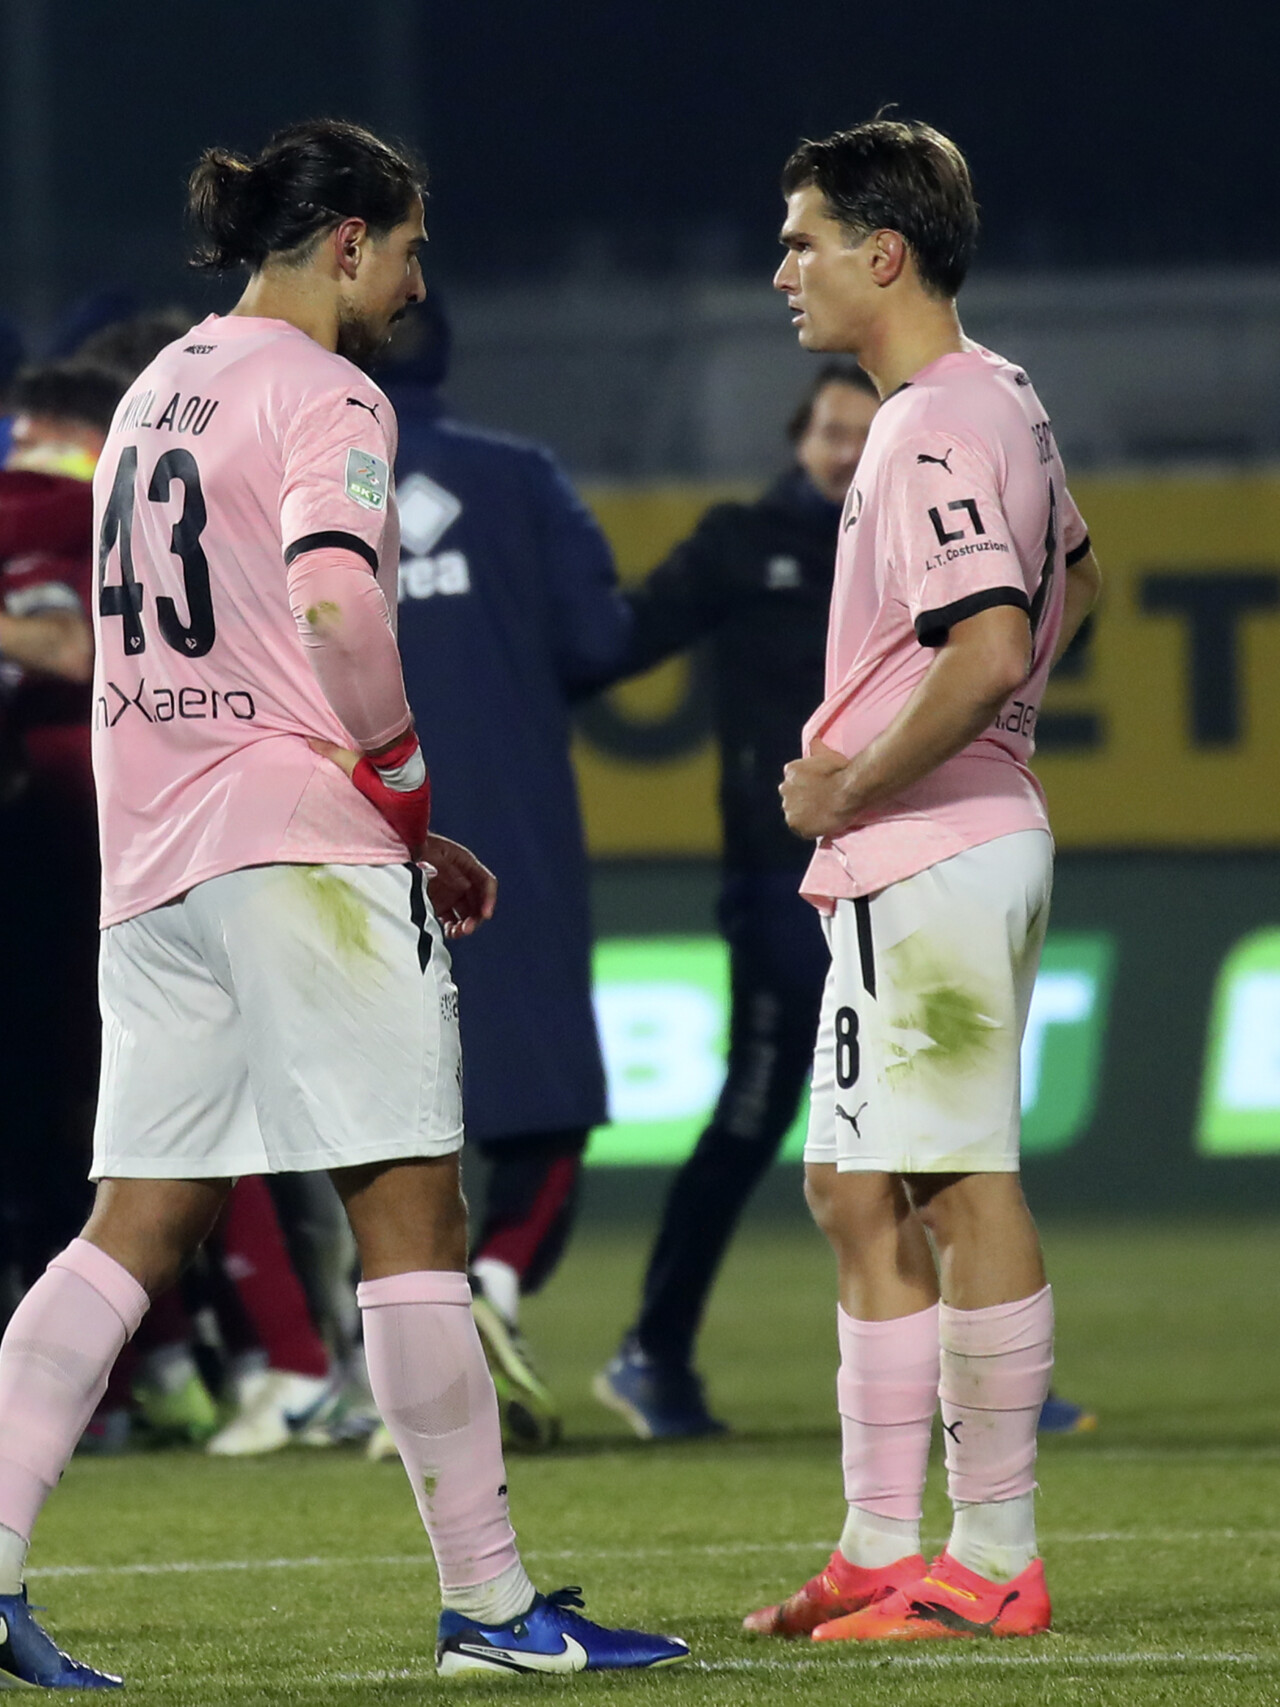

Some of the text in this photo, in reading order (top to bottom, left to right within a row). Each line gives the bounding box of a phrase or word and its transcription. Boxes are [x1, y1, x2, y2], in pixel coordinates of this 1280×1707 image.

[350, 483, 383, 504] BKT
[98, 445, 216, 658] 43
[398, 549, 470, 601] rea
[835, 1006, 860, 1089] 8
